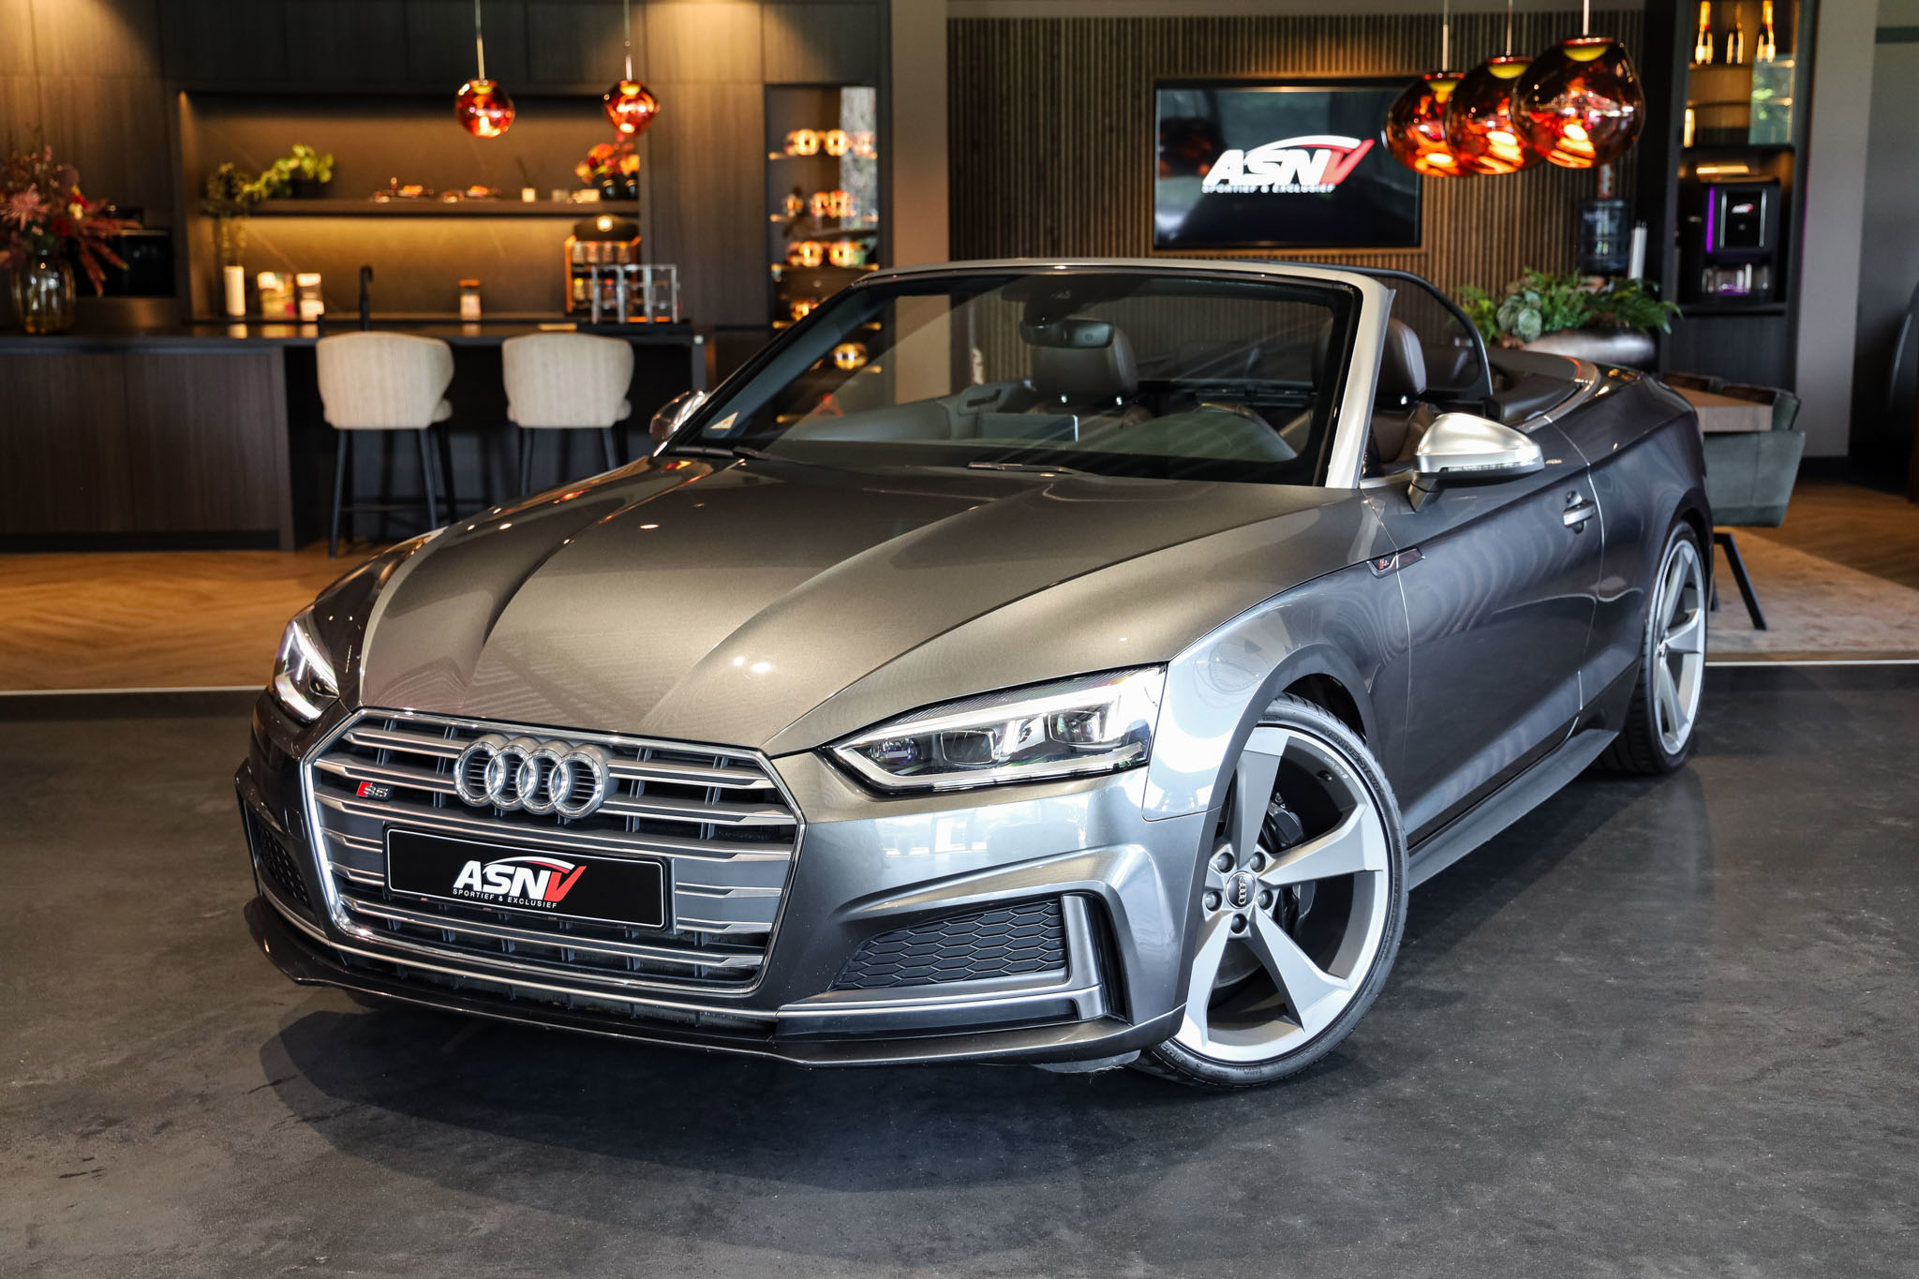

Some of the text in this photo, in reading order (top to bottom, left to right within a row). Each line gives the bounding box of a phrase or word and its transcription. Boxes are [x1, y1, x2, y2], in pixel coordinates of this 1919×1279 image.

[363, 784, 389, 798] S5
[453, 860, 587, 902] ASNV
[453, 888, 495, 900] SPORTIEF
[507, 896, 558, 909] EXCLUSIEF
